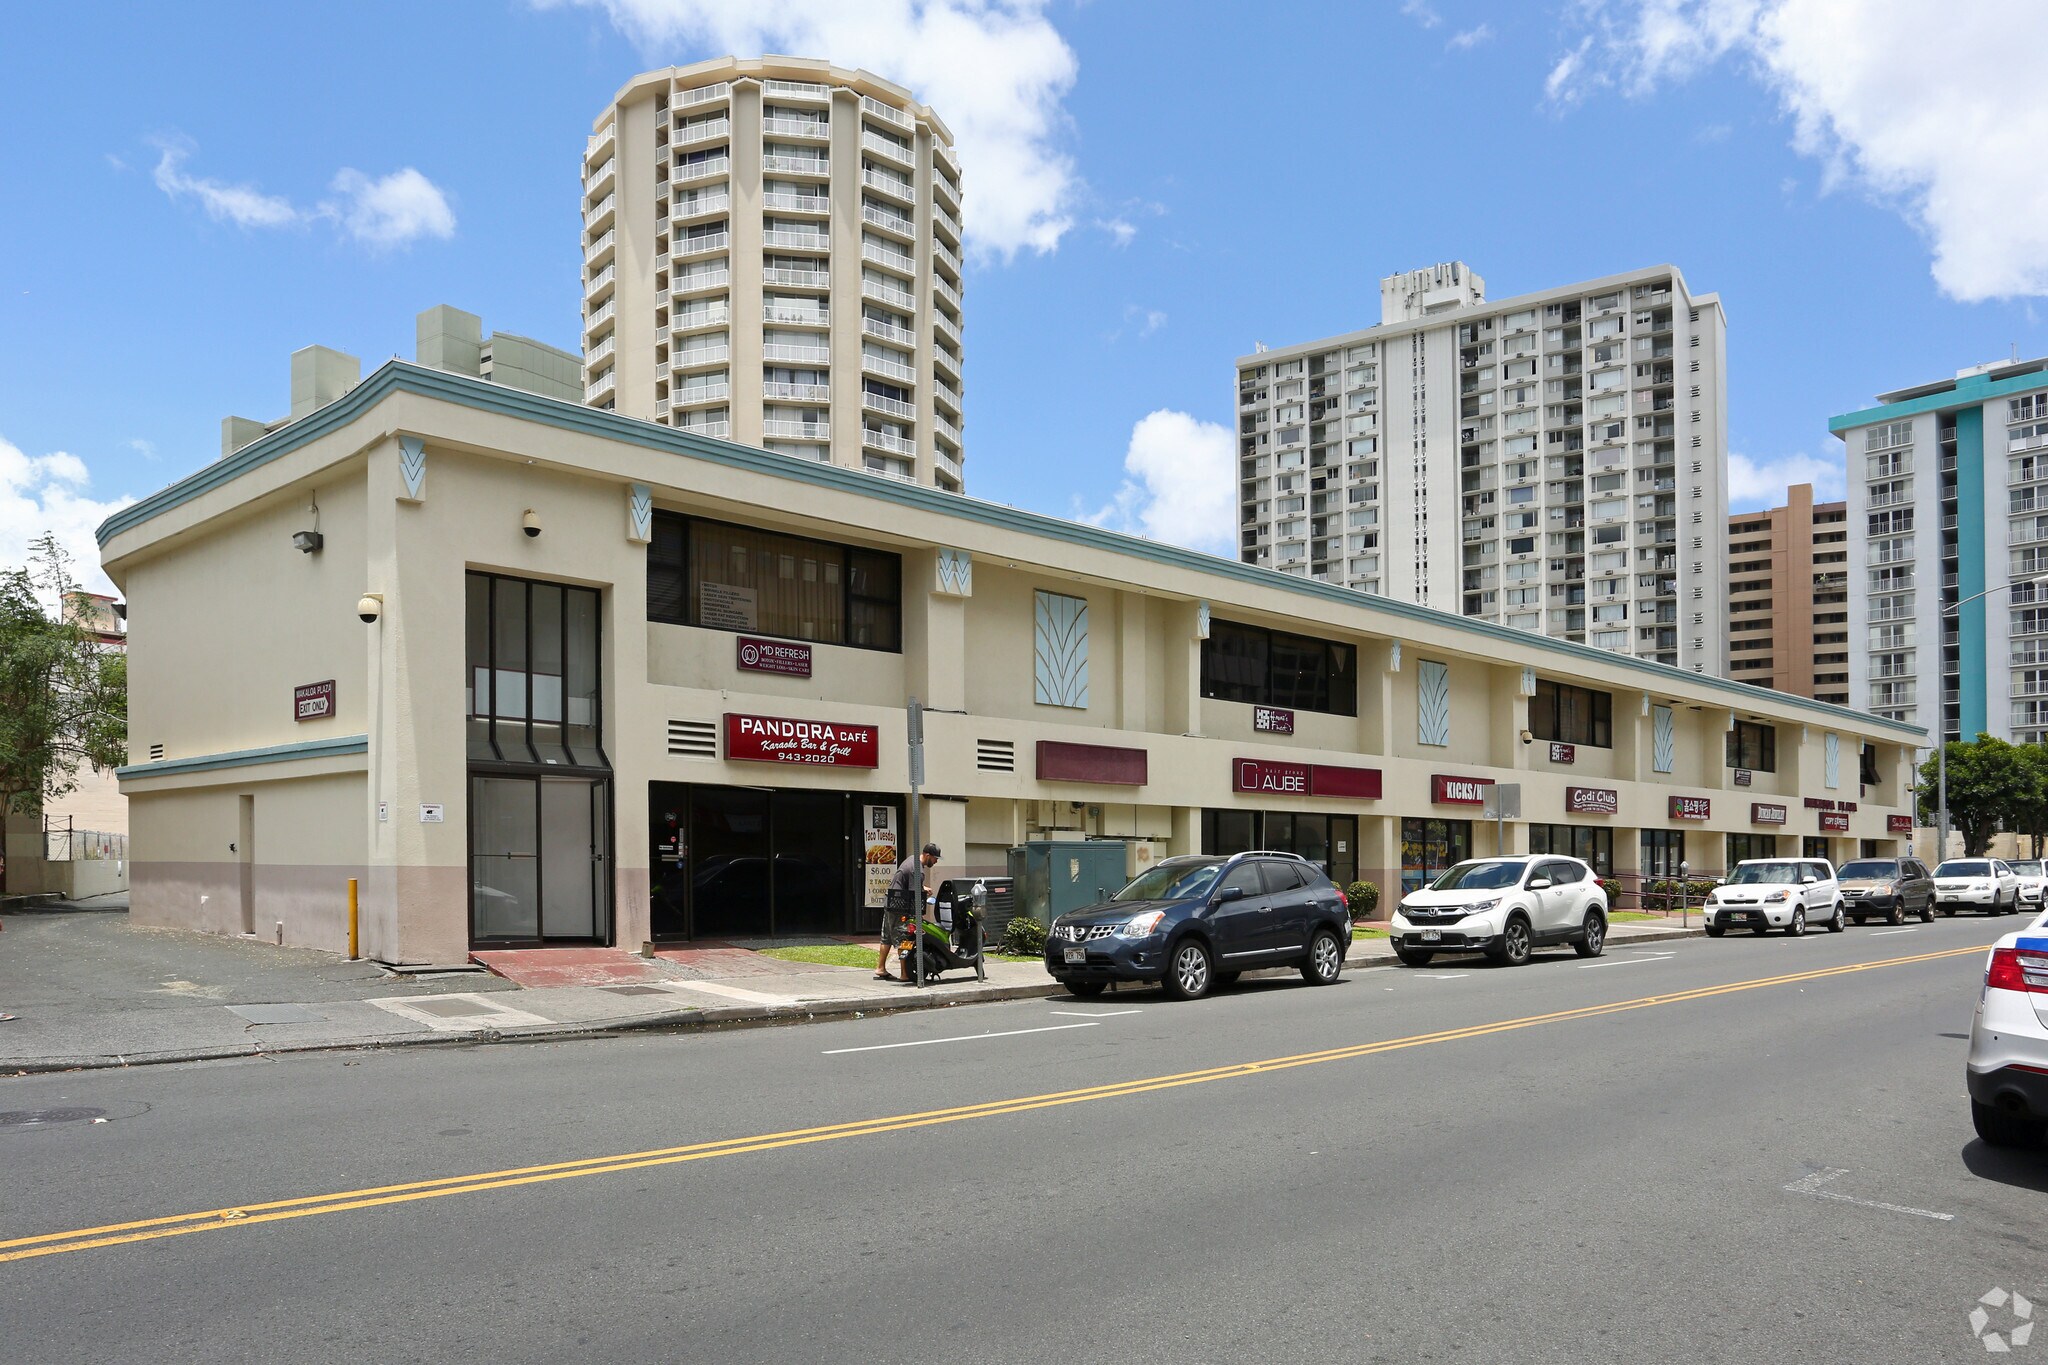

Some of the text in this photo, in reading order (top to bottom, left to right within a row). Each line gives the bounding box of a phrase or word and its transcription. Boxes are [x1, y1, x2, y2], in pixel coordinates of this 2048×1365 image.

[760, 645, 809, 660] MD REFRESH
[317, 684, 331, 695] PLAZA
[300, 700, 326, 714] EXIT ONLY
[740, 718, 868, 742] PANDORA CAFÉ
[761, 738, 851, 756] Karaoke Bar & Grill
[778, 752, 834, 763] 943-2020
[1262, 775, 1304, 792] AUBE
[1574, 790, 1616, 803] Codi Club
[865, 829, 896, 845] Taco Tuesday
[871, 867, 890, 875] $6.00
